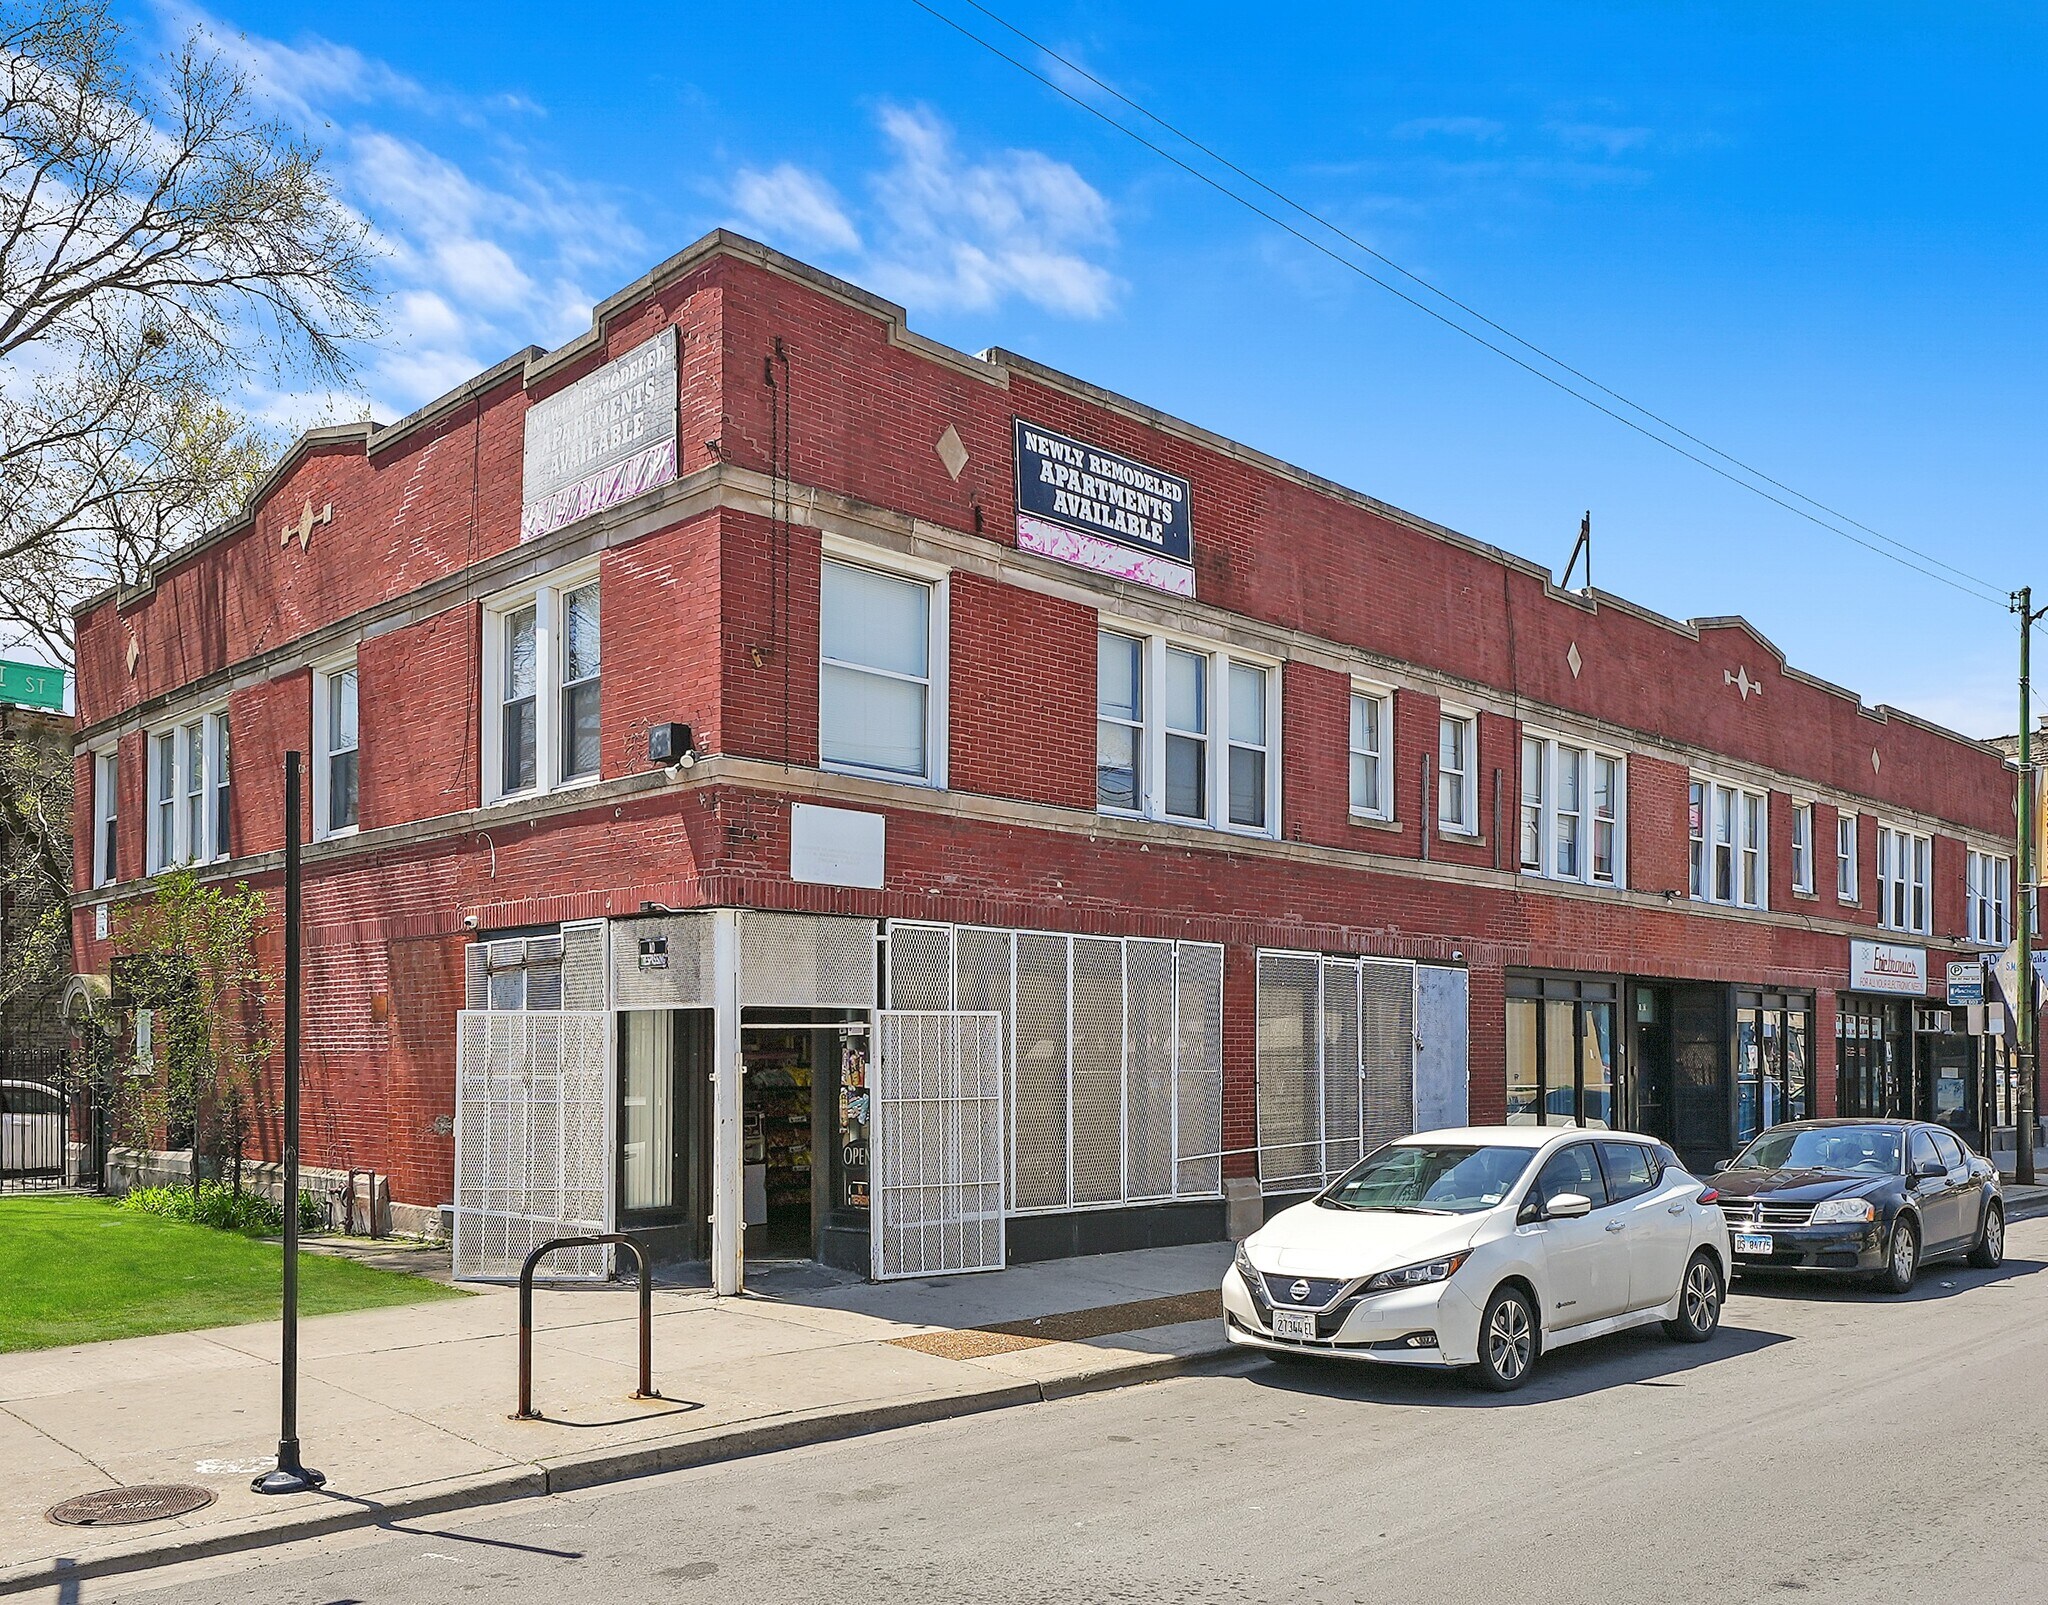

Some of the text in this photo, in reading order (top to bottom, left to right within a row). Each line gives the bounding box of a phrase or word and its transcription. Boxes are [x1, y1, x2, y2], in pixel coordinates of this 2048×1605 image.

[581, 345, 667, 406] REMODELED
[542, 376, 656, 454] APARTMENTS
[550, 411, 645, 478] AVAILABLE
[1024, 431, 1183, 503] NEWLY REMODELED
[1040, 460, 1173, 524] APARTMENTS
[1054, 489, 1164, 545] AVAILABLE
[25, 676, 46, 694] ST
[843, 1146, 870, 1166] OPEN
[1277, 1319, 1314, 1336] 27344 EL
